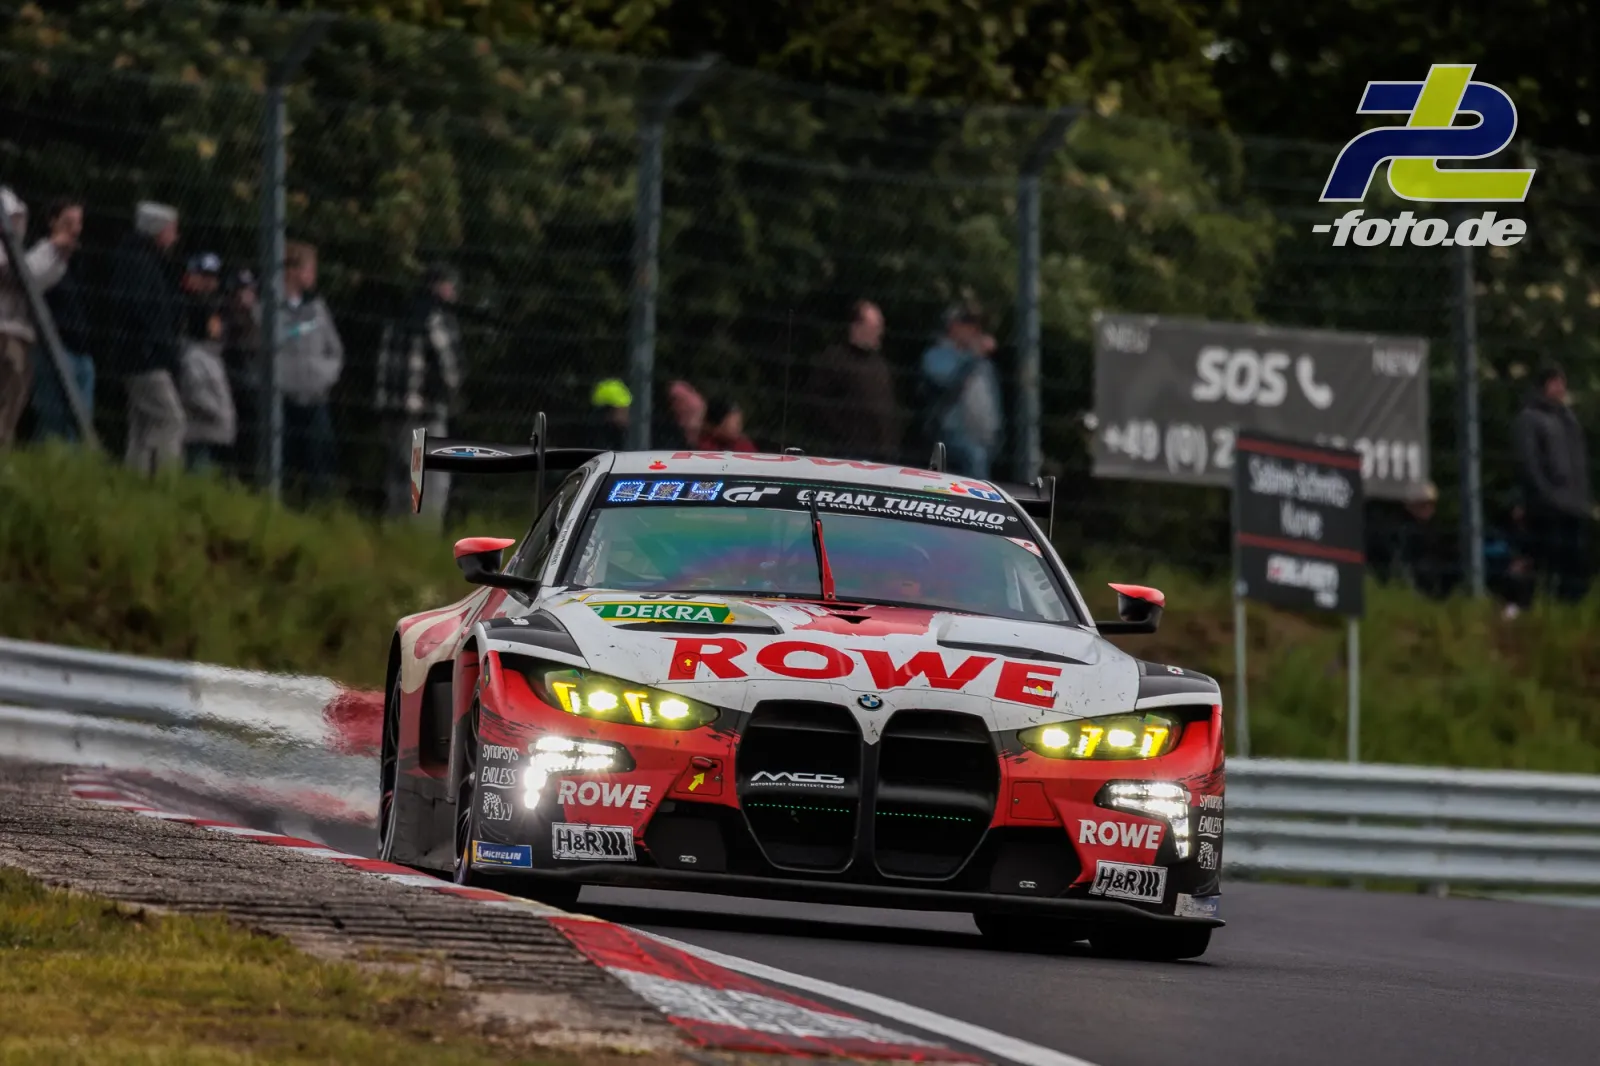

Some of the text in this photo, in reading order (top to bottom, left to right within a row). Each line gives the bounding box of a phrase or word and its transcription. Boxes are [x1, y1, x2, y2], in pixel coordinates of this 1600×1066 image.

[1192, 346, 1291, 406] SOS
[796, 489, 875, 507] GRAN
[829, 502, 864, 511] REAL
[868, 507, 924, 518] DRIVING
[927, 514, 1004, 531] SIMULATOR
[615, 605, 715, 622] DEKRA
[661, 637, 1062, 709] ROWE
[482, 744, 519, 763] SYNOPSYS
[481, 766, 518, 785] ENDLESS
[751, 771, 845, 784] MCG
[557, 780, 651, 809] ROWE
[555, 828, 603, 855] H&R
[1077, 819, 1162, 850] ROWE
[482, 850, 522, 860] MICHELIN
